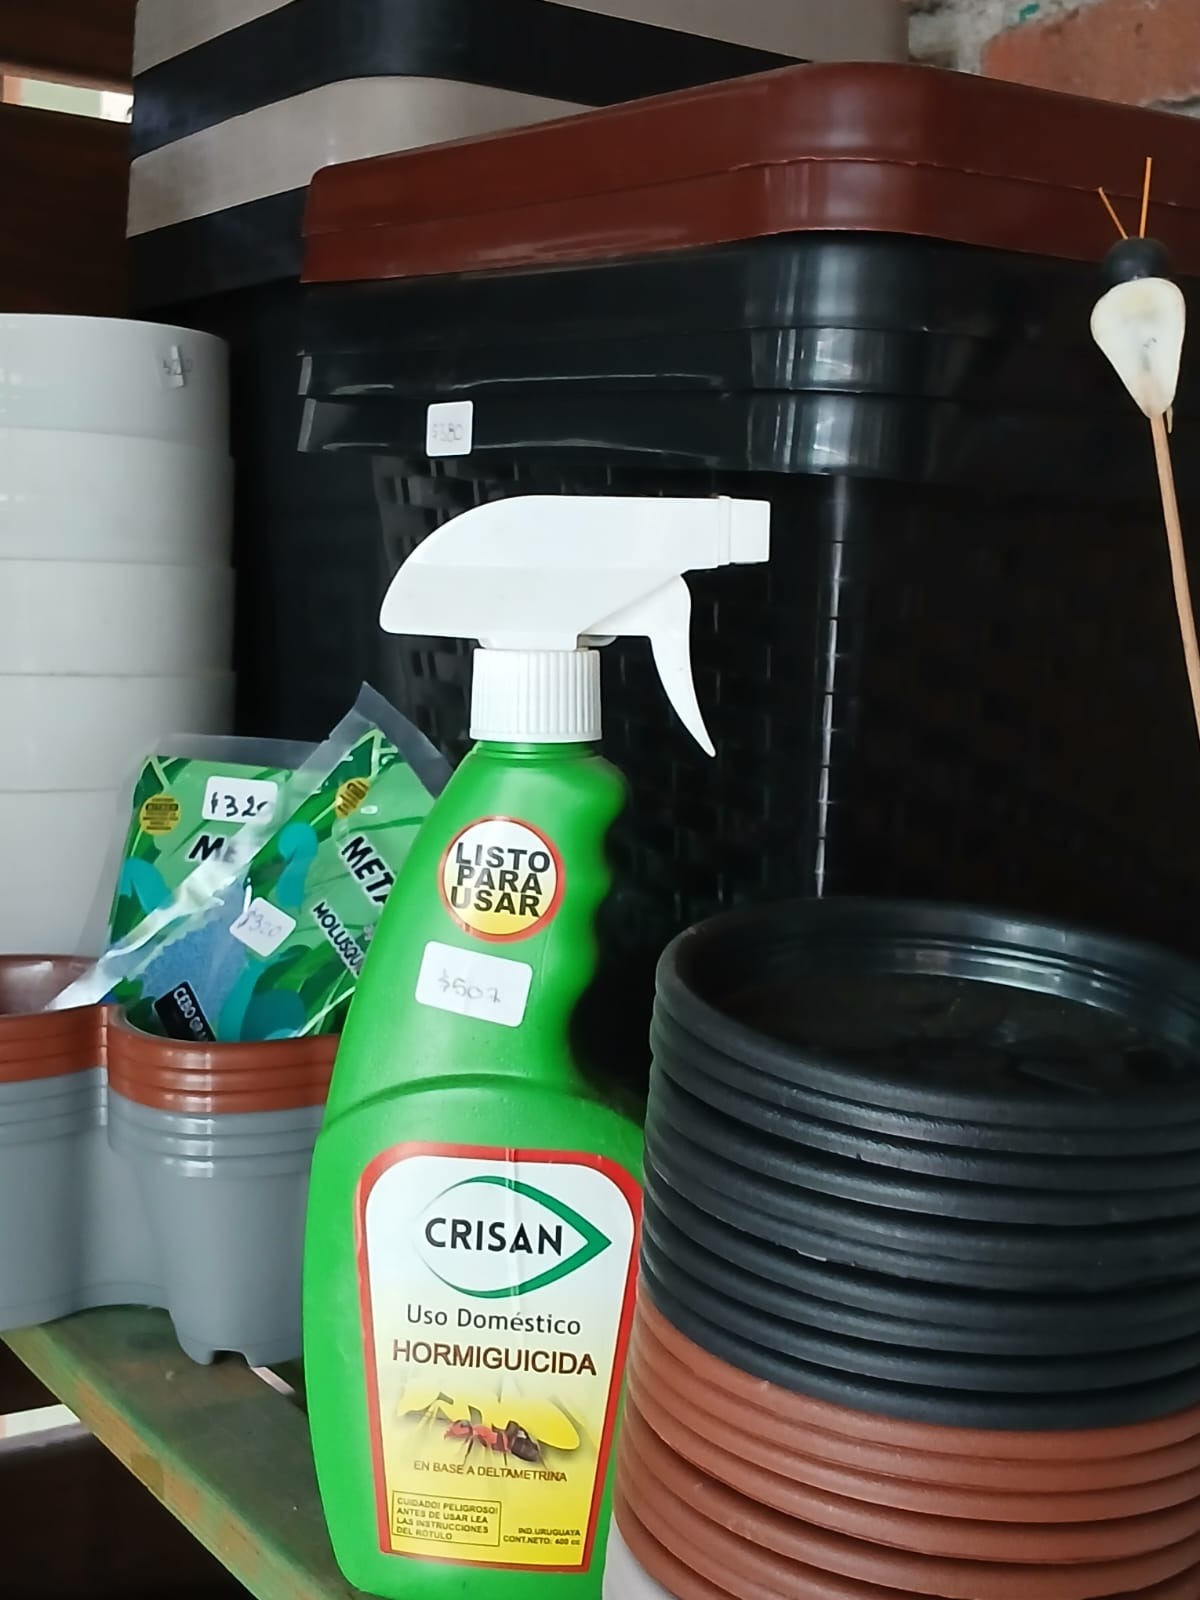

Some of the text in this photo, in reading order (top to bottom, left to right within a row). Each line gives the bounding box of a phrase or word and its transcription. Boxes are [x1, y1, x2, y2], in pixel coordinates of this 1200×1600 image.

[455, 842, 551, 873] LISTO
[457, 865, 542, 895] PARA
[450, 886, 540, 917] USAR
[425, 1217, 562, 1256] CRISAN
[407, 1304, 581, 1336] Uso Doméstico
[392, 1339, 597, 1376] HORMIGUICIDA
[414, 1460, 568, 1482] EN BASE A DELTAMETRINA
[396, 1507, 488, 1524] ANTES DE USAR LEA
[396, 1517, 488, 1534] LAS INSTRUCCIONES
[396, 1526, 413, 1535] DEL
